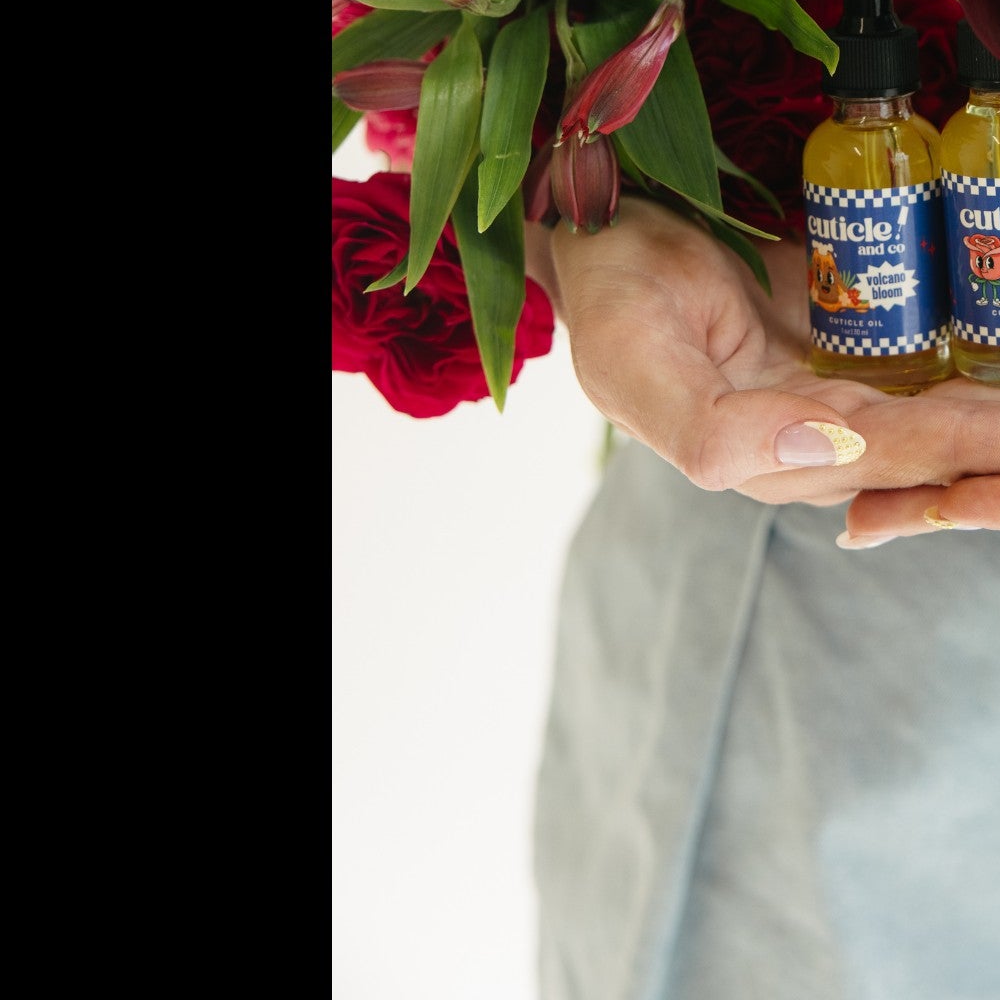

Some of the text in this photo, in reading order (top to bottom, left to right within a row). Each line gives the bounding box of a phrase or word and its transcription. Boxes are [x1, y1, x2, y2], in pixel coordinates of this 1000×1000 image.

[857, 243, 906, 256] and co
[866, 272, 906, 286] volcano
[872, 286, 903, 300] bloom
[828, 316, 864, 327] CUTICLE
